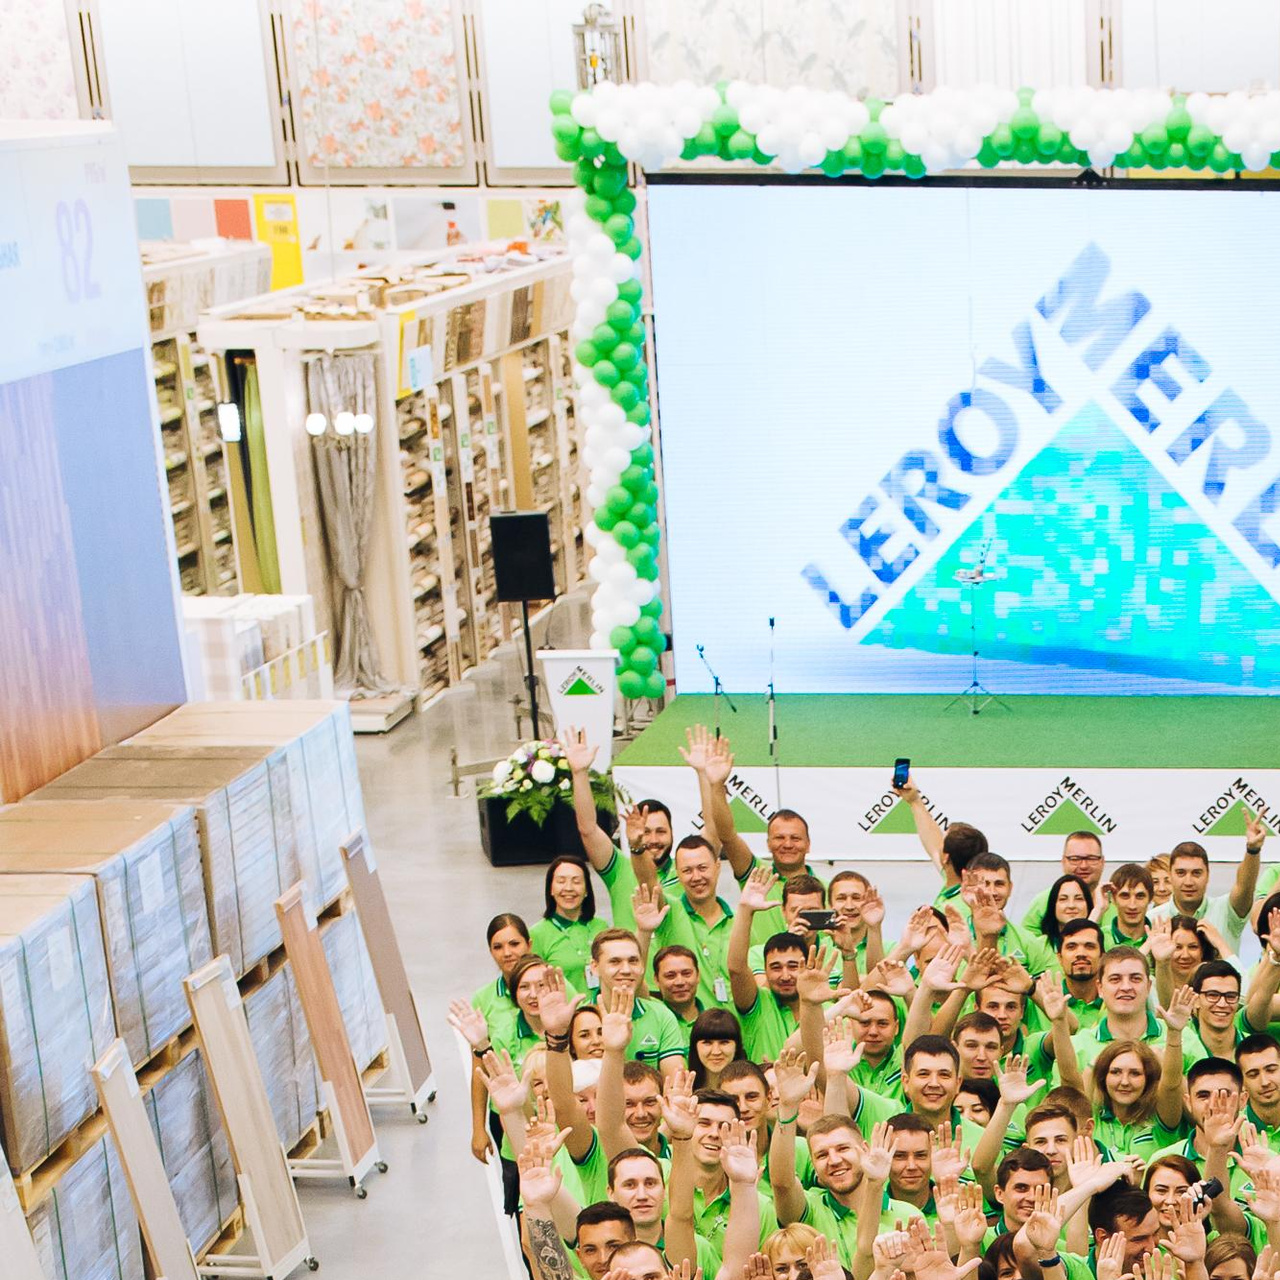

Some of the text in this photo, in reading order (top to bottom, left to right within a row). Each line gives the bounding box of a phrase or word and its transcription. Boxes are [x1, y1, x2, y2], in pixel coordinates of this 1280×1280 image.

[800, 320, 1065, 629] LEROY
[1021, 776, 1117, 833] LEROY MERLIN
[1192, 787, 1236, 834] LEROY
